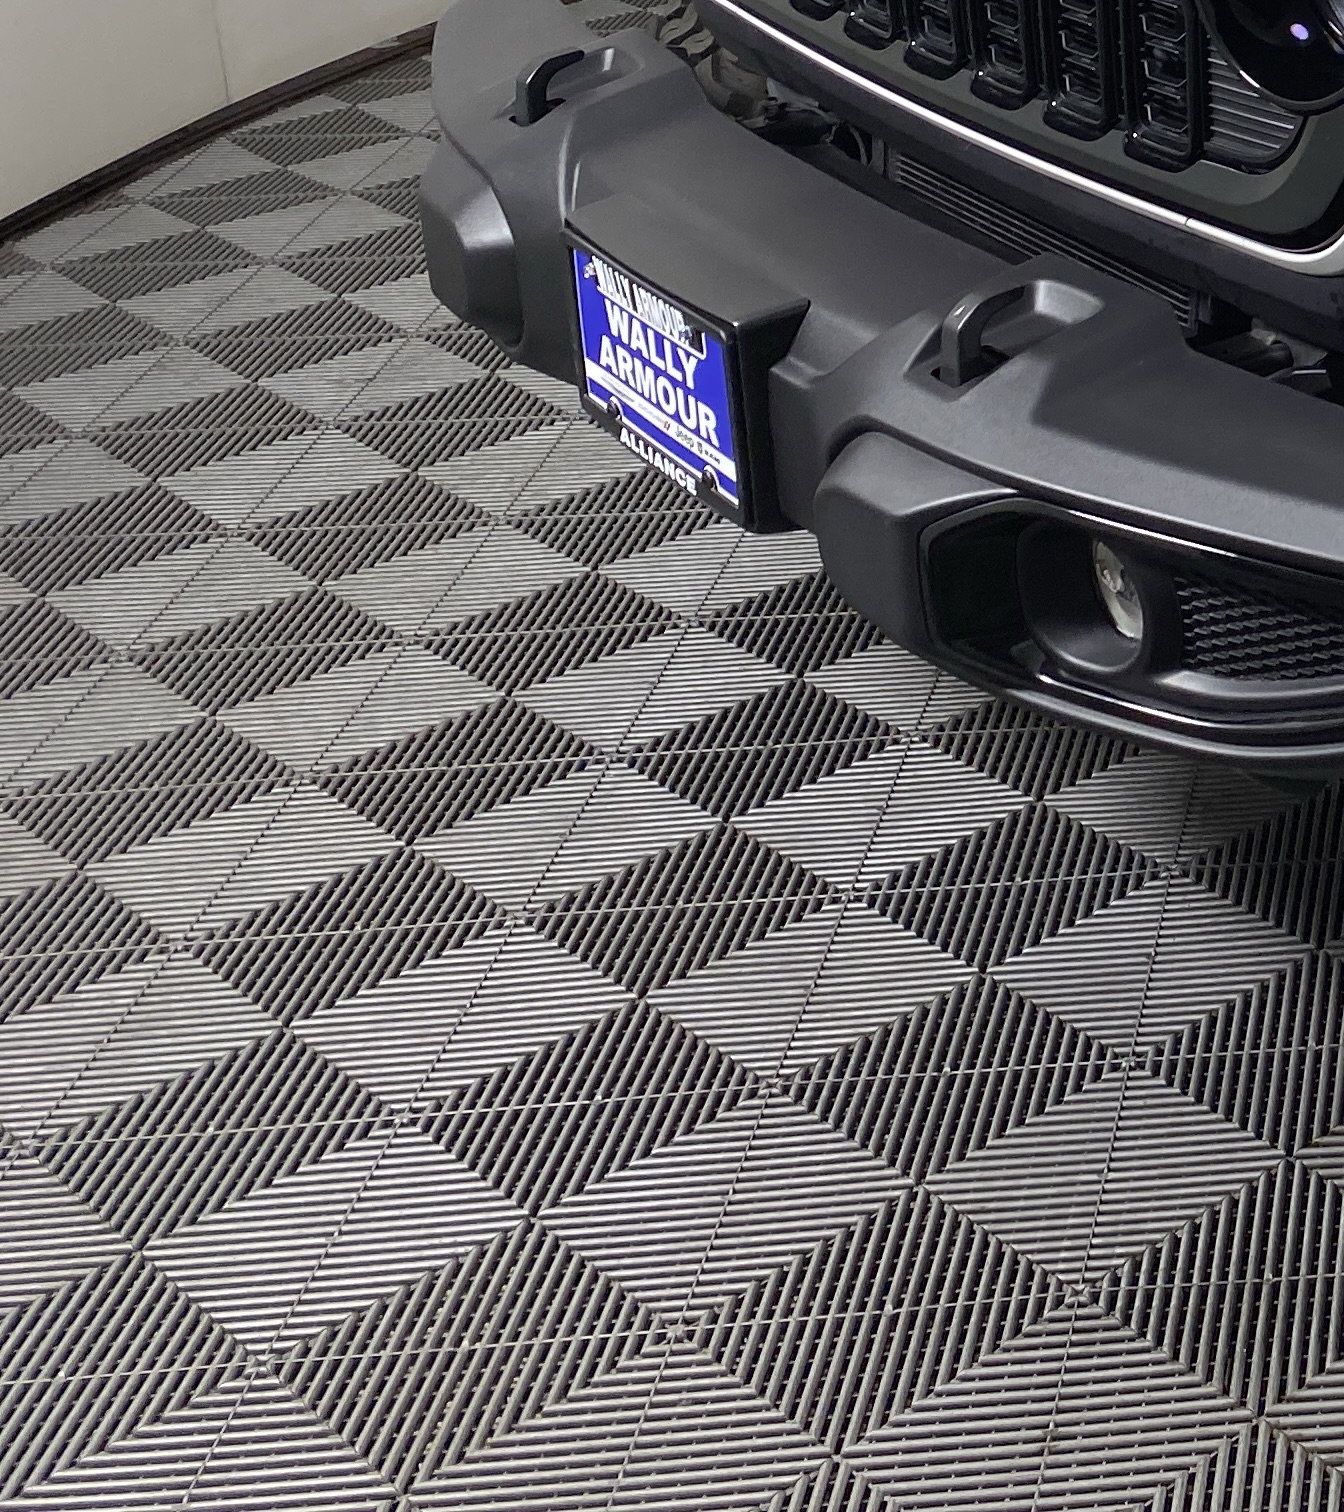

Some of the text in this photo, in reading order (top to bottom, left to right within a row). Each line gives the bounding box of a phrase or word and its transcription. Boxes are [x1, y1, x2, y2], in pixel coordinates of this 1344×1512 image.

[604, 298, 698, 389] WALLY
[599, 334, 720, 448] ARMOUR
[619, 426, 697, 496] ALLIANCE
